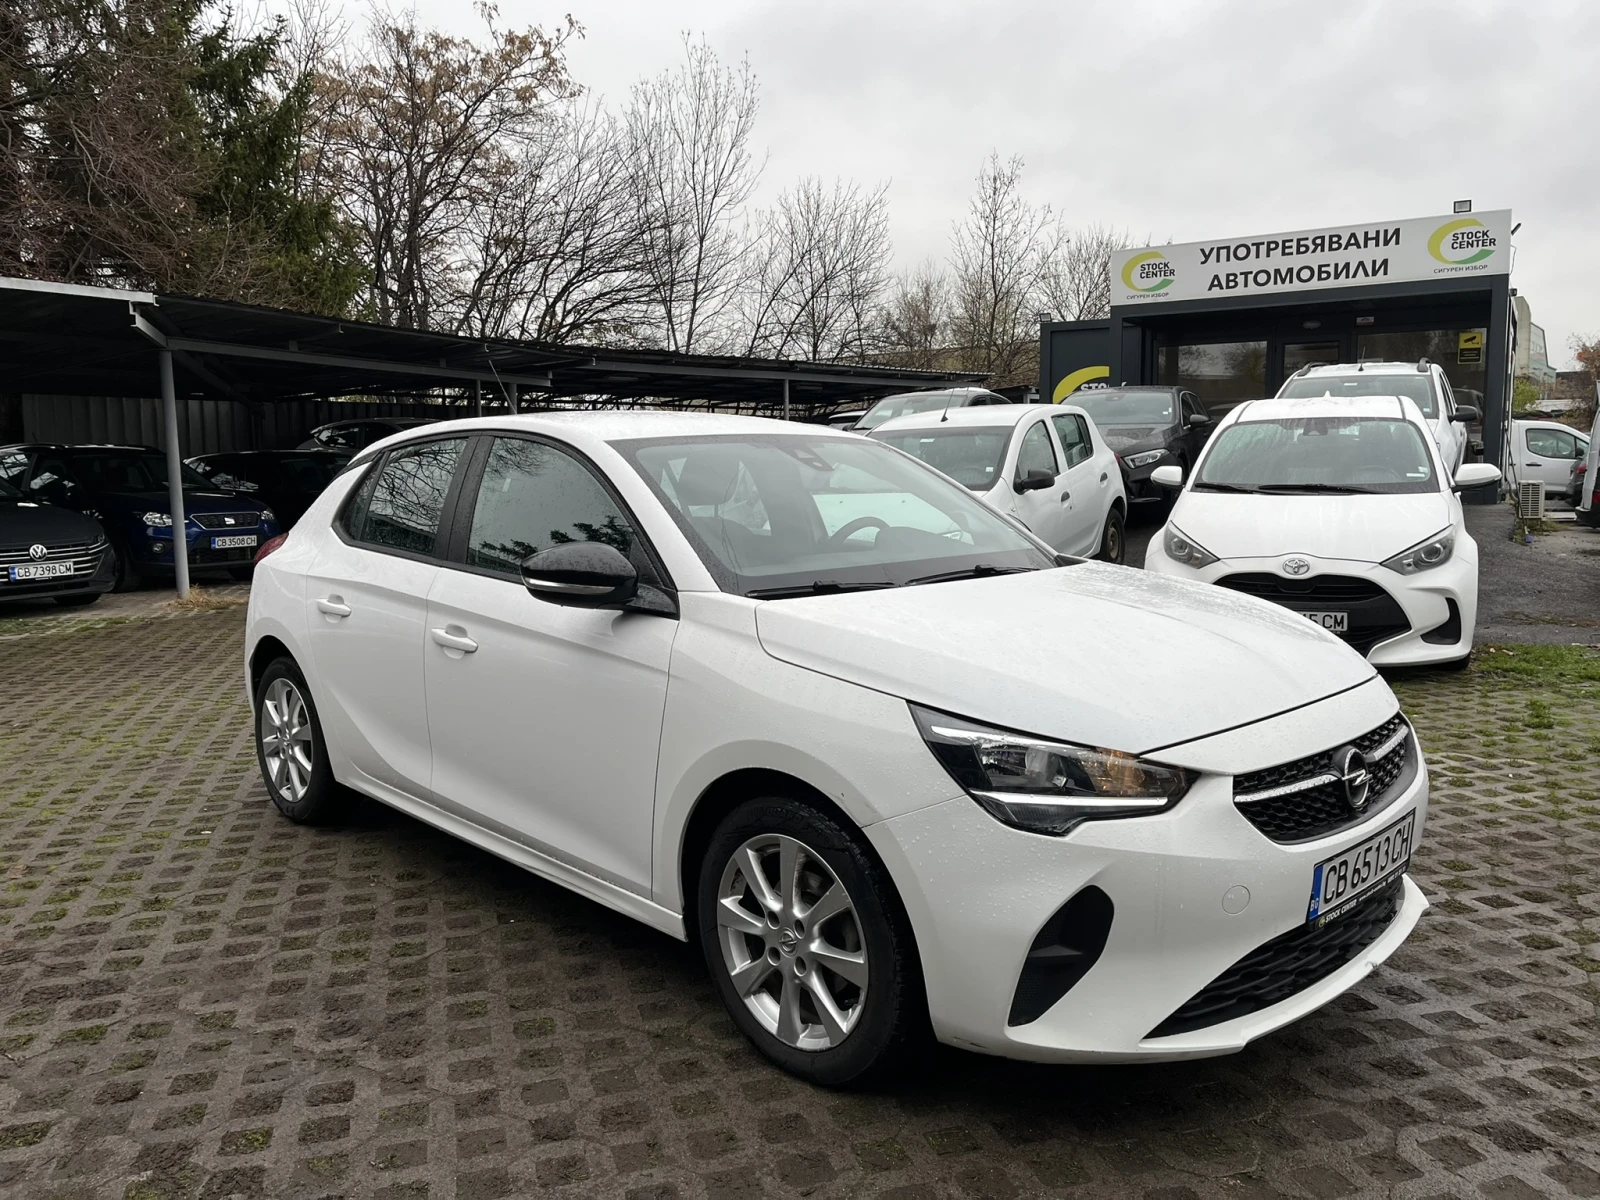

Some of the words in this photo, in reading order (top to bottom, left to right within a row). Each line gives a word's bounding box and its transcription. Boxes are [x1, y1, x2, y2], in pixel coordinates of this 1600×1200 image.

[1452, 229, 1490, 241] STOCK
[1200, 228, 1400, 265] УПОТРЕБЯВАНИ
[1451, 238, 1496, 250] CENTER
[1140, 261, 1170, 271] STOCK
[1433, 266, 1463, 274] СИГУРЕН
[1140, 269, 1175, 279] CENTER
[1207, 258, 1389, 291] АВТОМОБИЛИ
[17, 567, 31, 577] CB
[33, 565, 57, 576] 7398
[59, 563, 72, 574] CM
[1351, 836, 1391, 889] 6513
